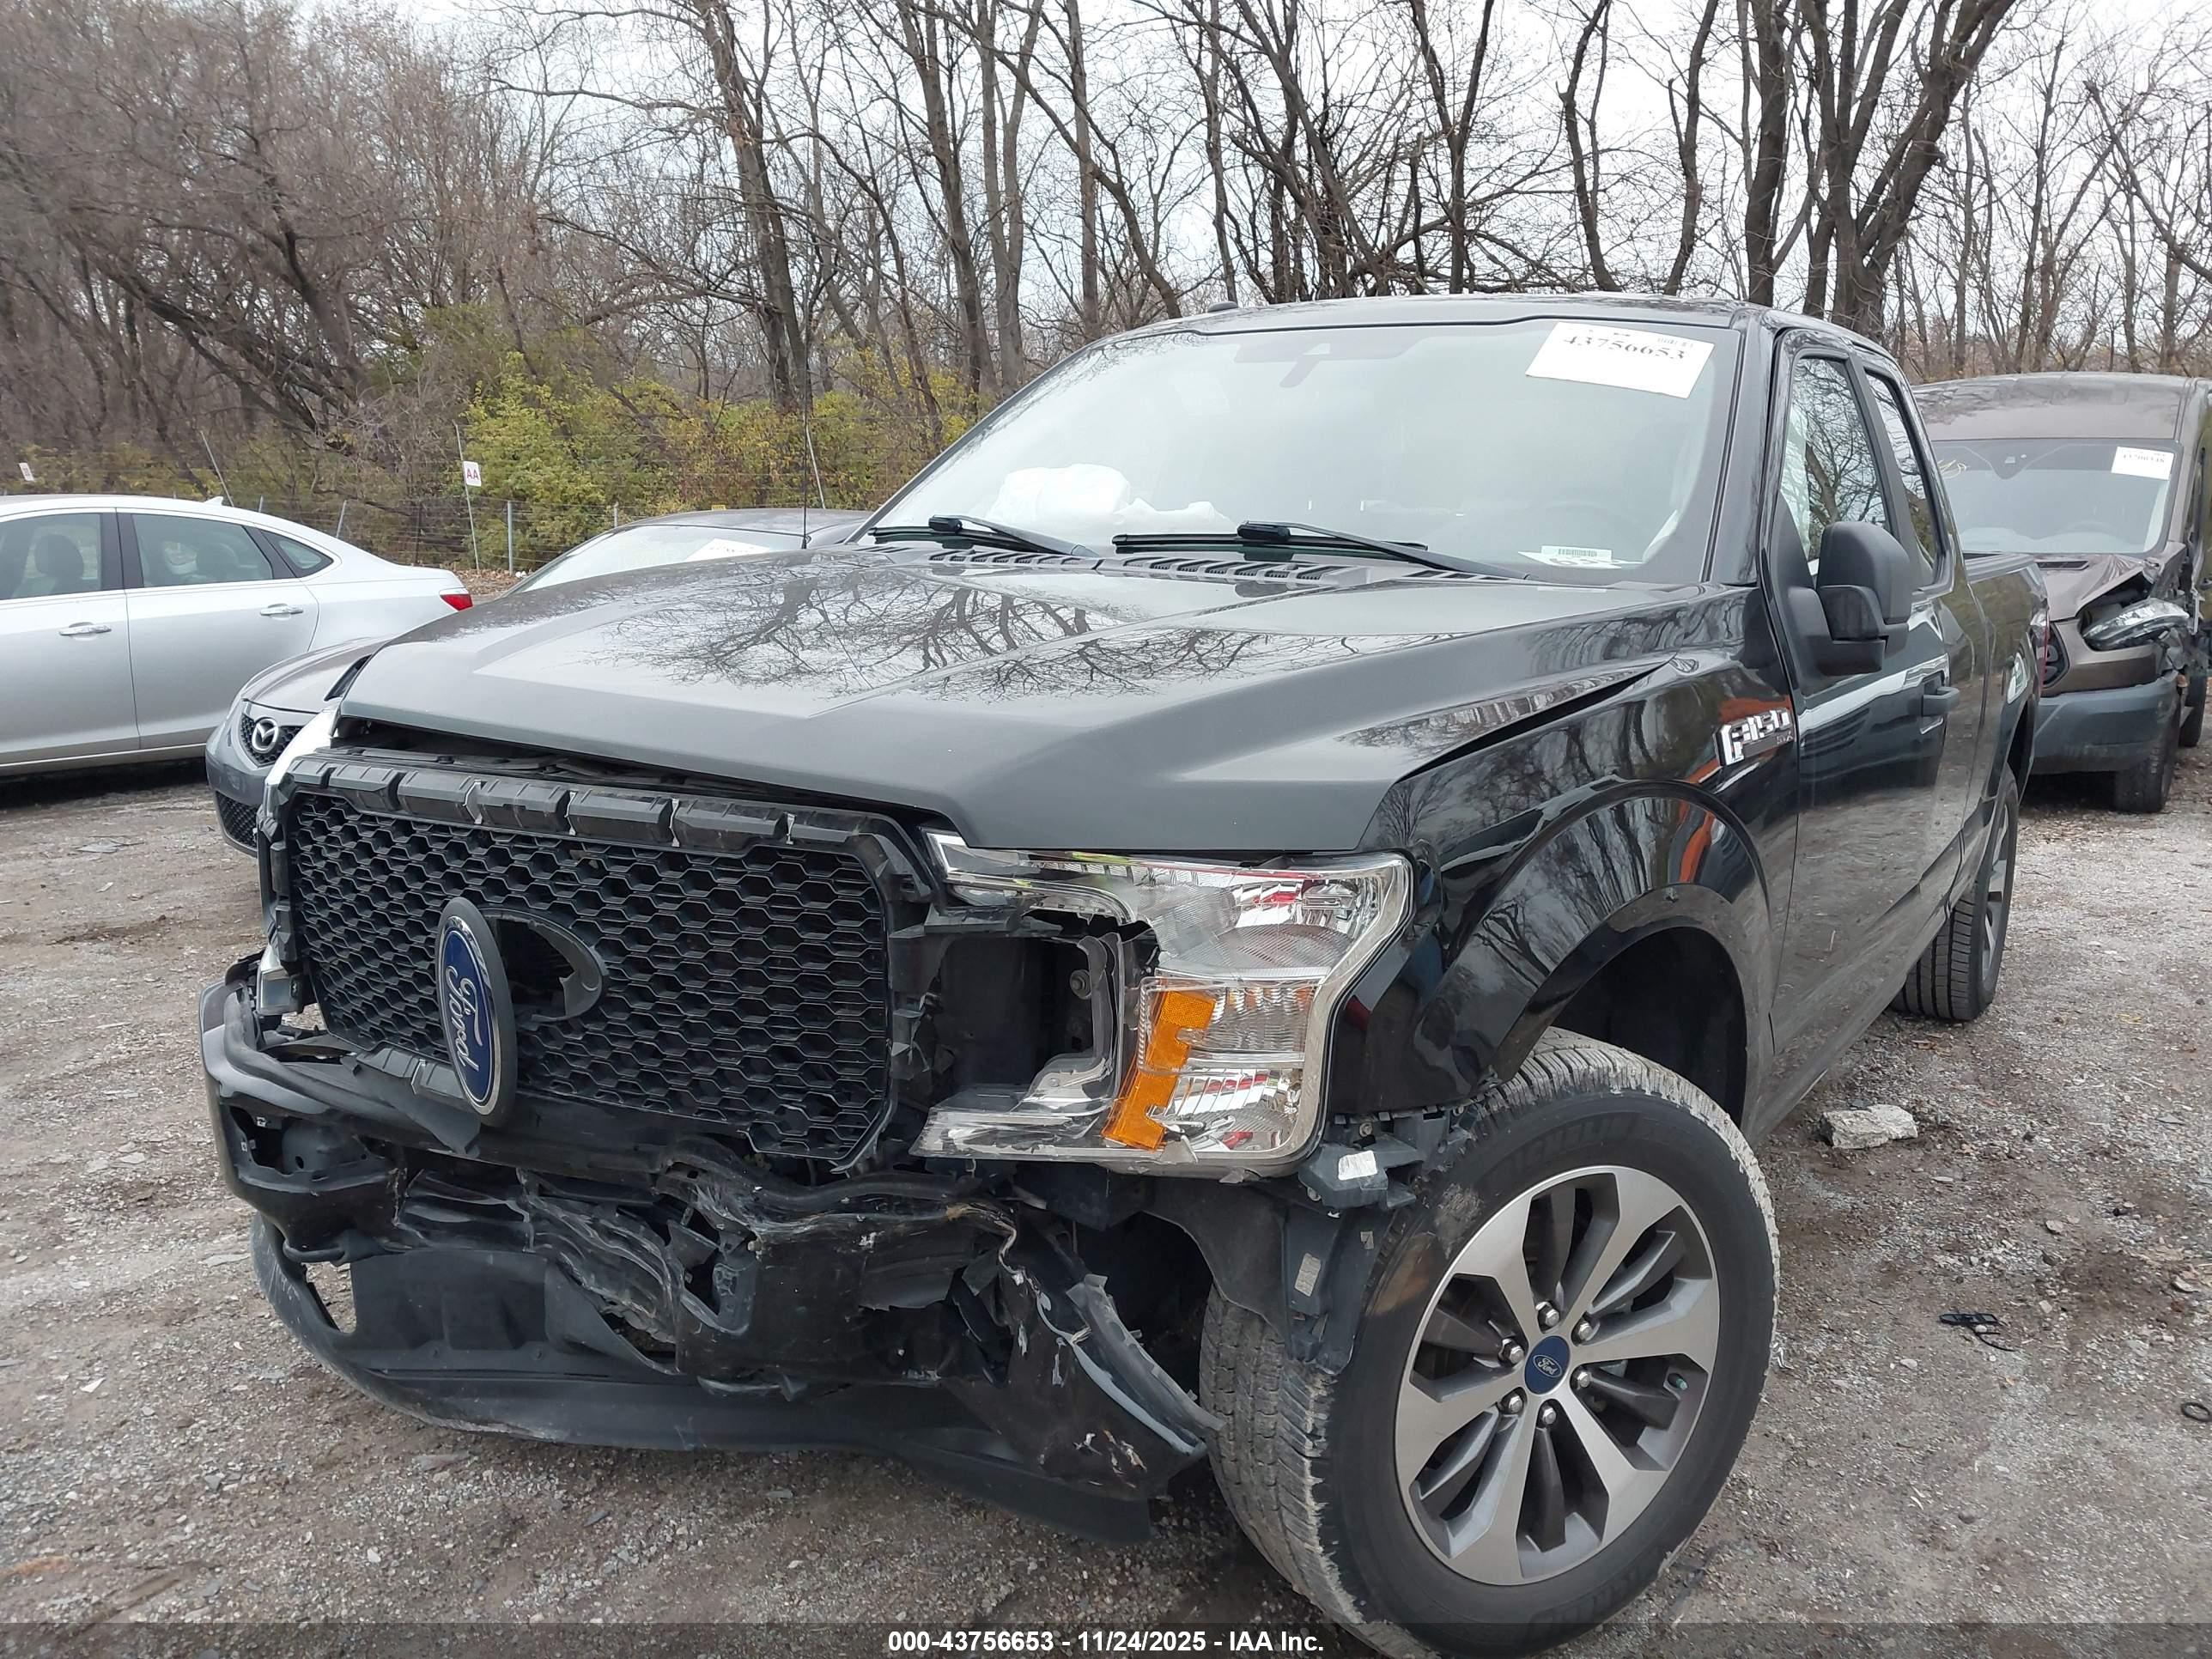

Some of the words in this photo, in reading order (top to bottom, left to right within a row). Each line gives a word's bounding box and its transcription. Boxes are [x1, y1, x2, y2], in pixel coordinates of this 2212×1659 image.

[1563, 335, 1686, 360] 43756653
[466, 467, 480, 481] AA
[445, 965, 483, 1073] Ford
[1537, 1357, 1559, 1376] Ford
